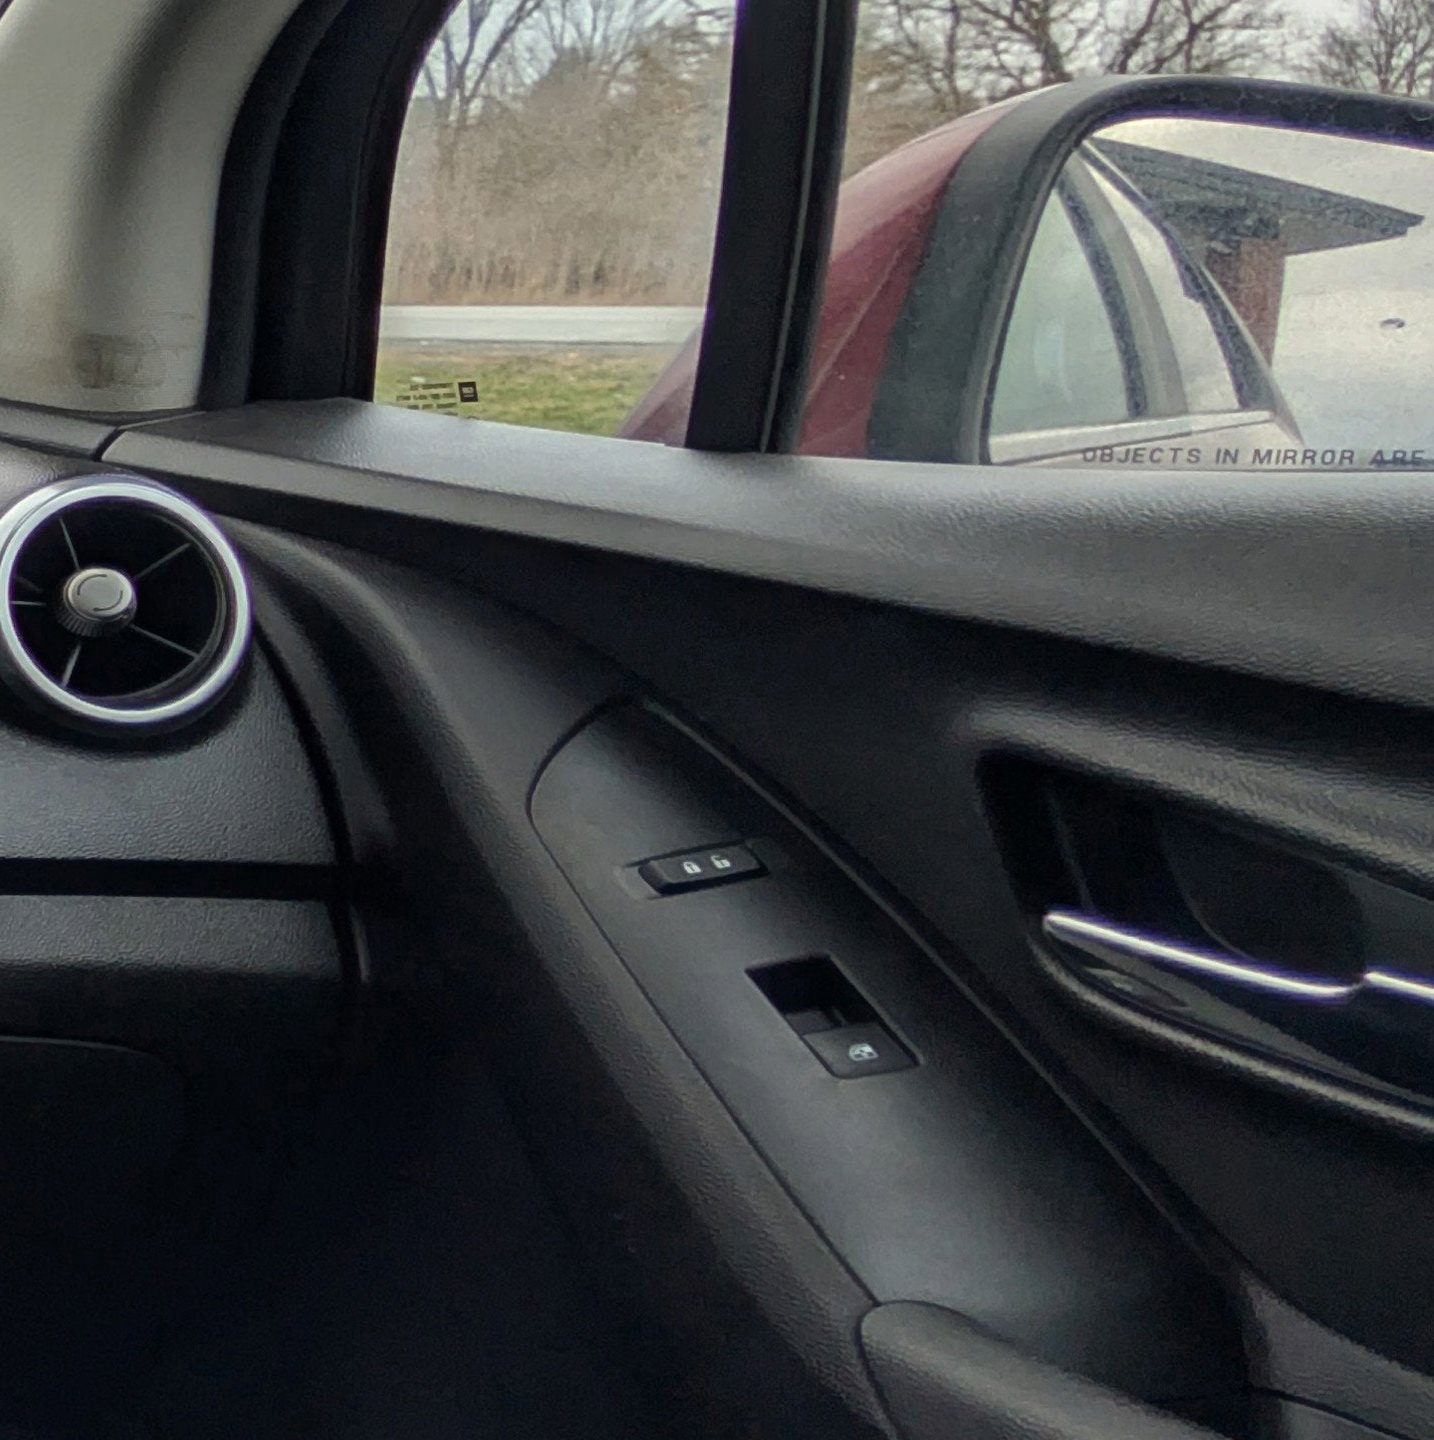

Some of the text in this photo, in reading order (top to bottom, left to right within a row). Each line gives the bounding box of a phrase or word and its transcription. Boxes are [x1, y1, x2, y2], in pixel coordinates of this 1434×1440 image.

[1083, 447, 1201, 464] OBJECTS
[1214, 448, 1240, 465] IN
[1251, 448, 1355, 466] MIRROR
